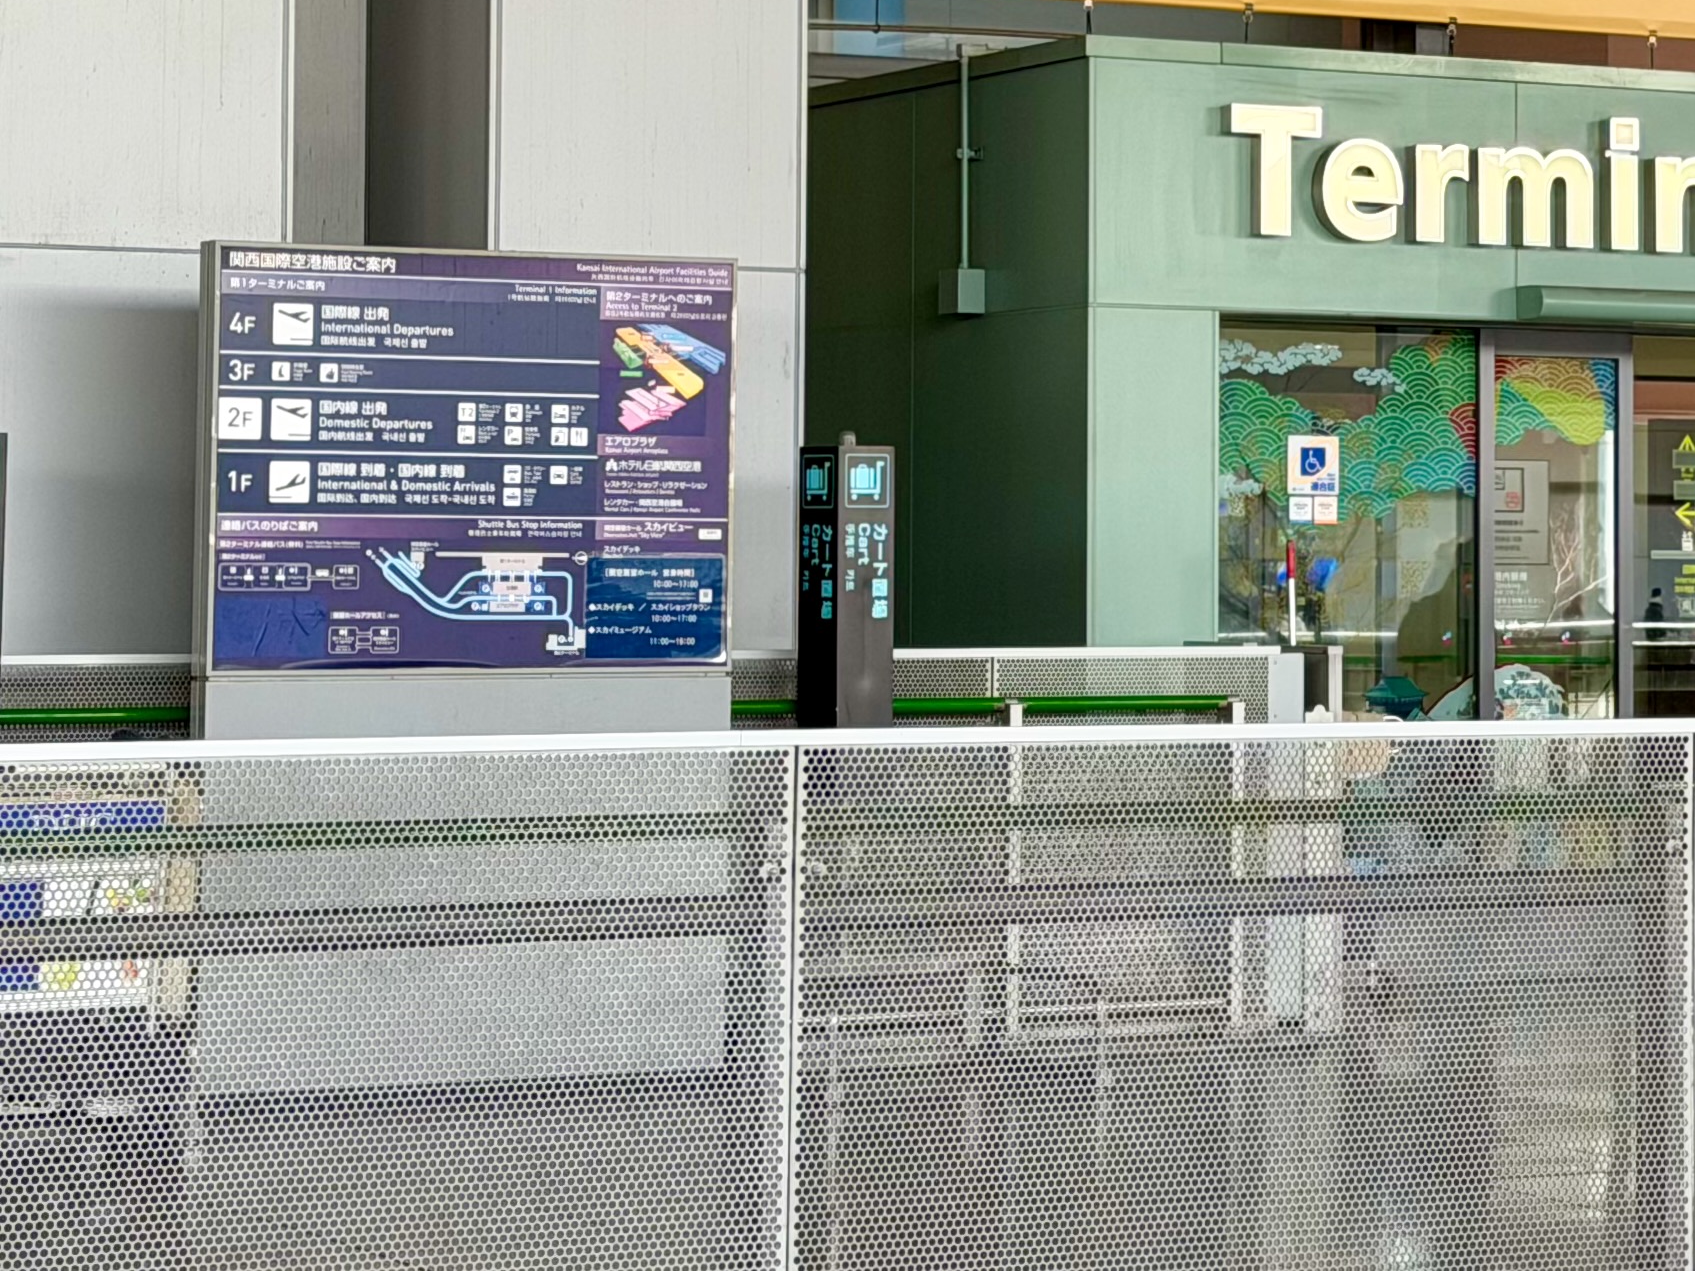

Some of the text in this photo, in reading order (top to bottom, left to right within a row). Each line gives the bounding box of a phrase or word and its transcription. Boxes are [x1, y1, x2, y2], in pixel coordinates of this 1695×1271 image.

[229, 251, 396, 274] 関西国際空港施設ご案内
[602, 264, 647, 274] International
[650, 265, 674, 276] Airport
[676, 266, 706, 277] Facilities
[515, 284, 545, 293] Terminal
[555, 286, 597, 296] Information
[364, 306, 389, 321] 出発
[605, 302, 630, 310] Access
[641, 303, 671, 312] Terminal
[229, 312, 256, 334] 4F
[321, 322, 454, 337] International Departures
[228, 359, 255, 381] 3F
[362, 401, 387, 415] 出発
[227, 407, 253, 427] 2F
[319, 416, 433, 431] Domestic Departures
[605, 436, 657, 447] エアロプラザ
[227, 471, 253, 492] 1F
[317, 479, 495, 492] International & Domestic Arrivals
[478, 520, 583, 530] Shuttle Bus Stop Information
[644, 522, 694, 533] スカイビュー
[811, 524, 820, 566] Cart
[858, 523, 870, 565] Cart
